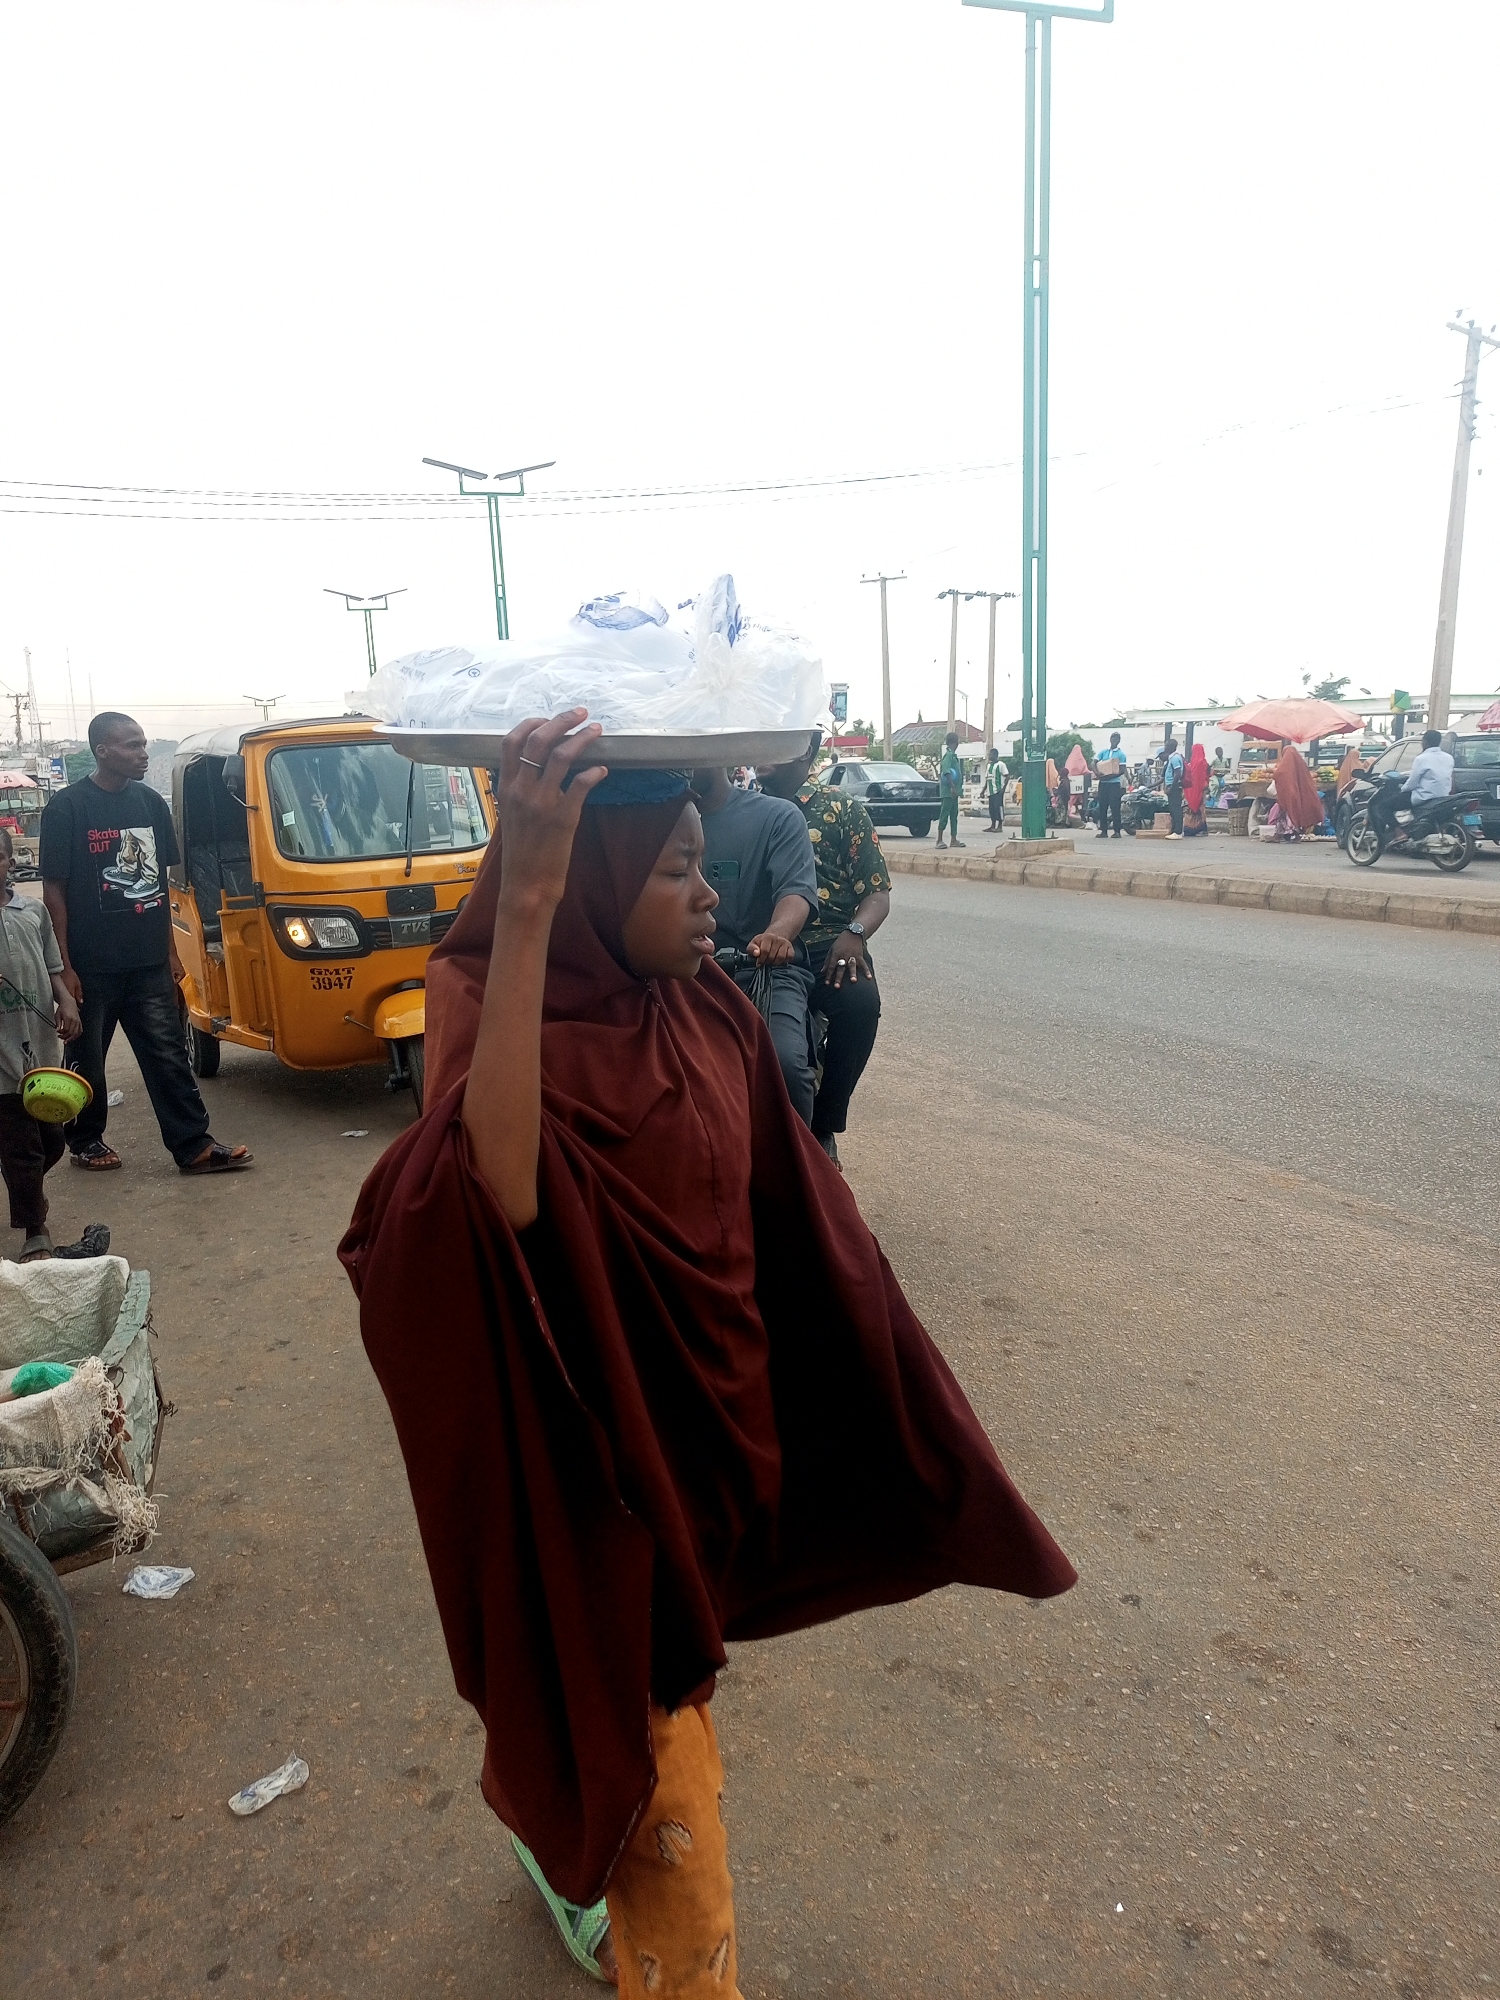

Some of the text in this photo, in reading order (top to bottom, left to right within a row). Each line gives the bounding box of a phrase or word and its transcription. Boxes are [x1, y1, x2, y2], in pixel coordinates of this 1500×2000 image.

[87, 828, 119, 840] Skate
[89, 841, 110, 853] OUT
[401, 921, 429, 934] TVS
[310, 967, 355, 975] GMT
[311, 976, 353, 990] 3947
